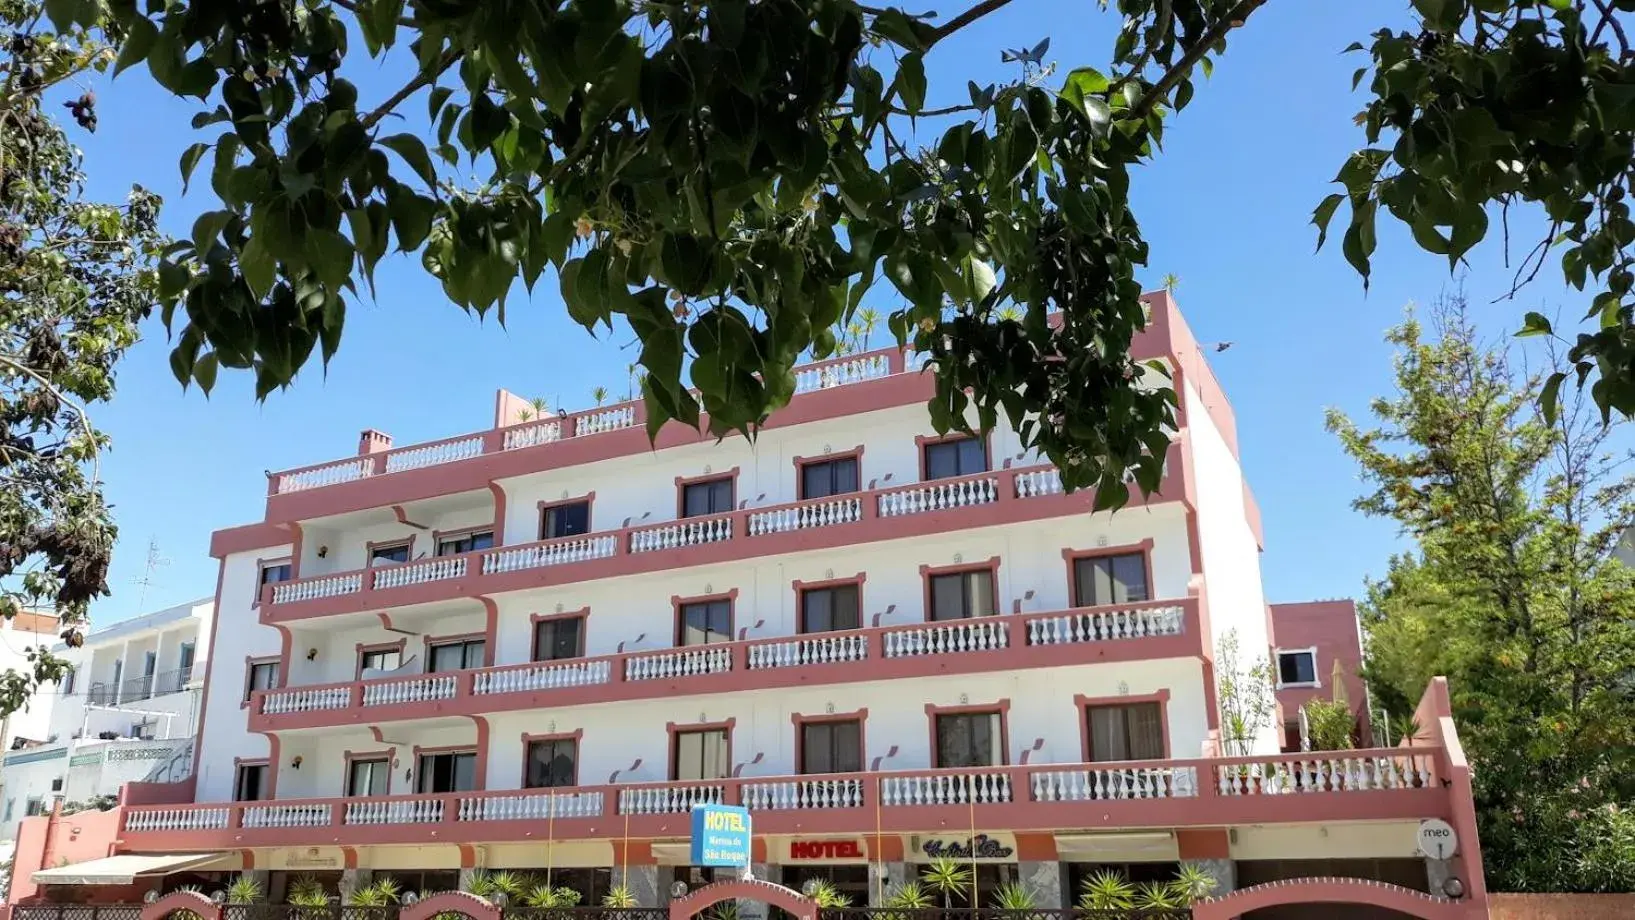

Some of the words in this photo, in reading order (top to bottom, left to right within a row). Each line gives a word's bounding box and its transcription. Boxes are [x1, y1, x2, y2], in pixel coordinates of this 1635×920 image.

[705, 811, 746, 832] HOTEL
[1423, 828, 1450, 837] meo
[791, 840, 864, 859] HOTEL
